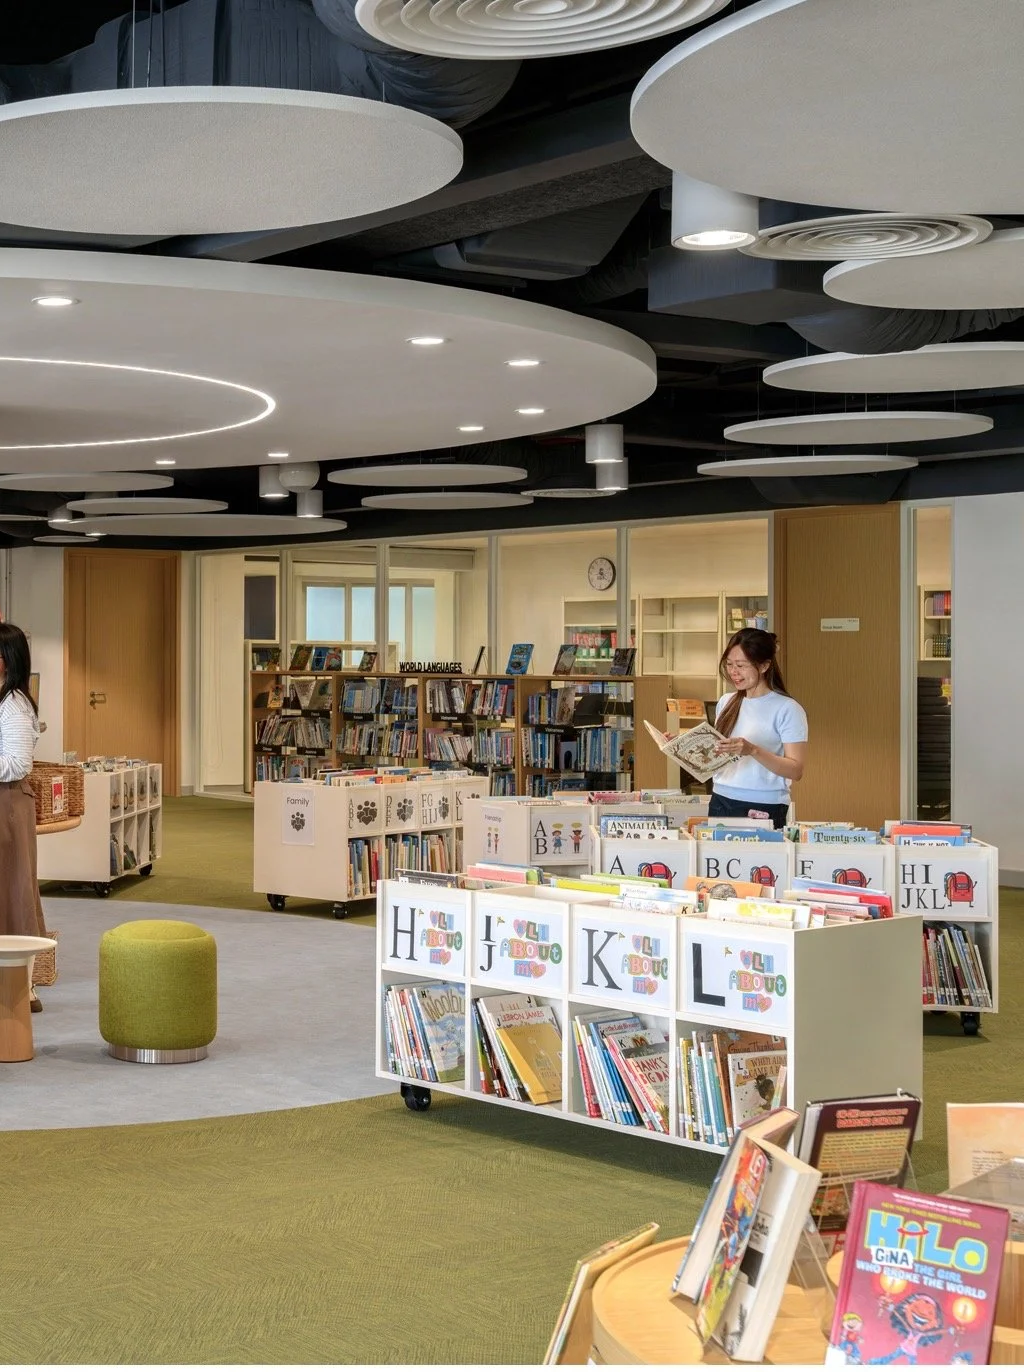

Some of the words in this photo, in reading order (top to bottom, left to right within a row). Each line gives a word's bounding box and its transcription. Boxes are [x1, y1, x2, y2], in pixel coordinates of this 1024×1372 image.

[400, 662, 422, 672] WORLD
[423, 662, 462, 673] LANGUAGES
[286, 796, 310, 806] Family
[348, 798, 354, 808] A
[386, 796, 392, 806] D
[456, 791, 462, 805] K
[348, 808, 354, 818] B
[386, 806, 392, 817] E
[456, 806, 463, 821] L
[348, 819, 354, 829] C
[386, 817, 392, 827] F
[610, 821, 656, 832] ANIMALIA
[534, 820, 548, 837] A
[814, 832, 866, 844] Twenty-six
[535, 838, 548, 855] B
[608, 854, 626, 875] A
[681, 906, 688, 914] K
[390, 906, 418, 961] H
[480, 916, 496, 942] I
[480, 944, 496, 972] J
[582, 928, 622, 990] K
[692, 942, 726, 1007] L
[421, 990, 426, 998] H
[527, 996, 532, 1004] J
[525, 1010, 544, 1020] JAMES
[497, 1018, 501, 1027] J
[600, 1030, 607, 1038] K
[618, 1040, 626, 1048] K
[632, 1056, 668, 1073] HANK'S
[738, 1062, 744, 1070] L
[751, 1056, 770, 1067] WHEN
[639, 1072, 656, 1085] BIG
[856, 1260, 882, 1274] WHO
[883, 1266, 920, 1284] BROKE
[923, 1274, 944, 1289] THE
[946, 1281, 987, 1299] WORLD
[914, 1264, 935, 1277] THE
[936, 1268, 962, 1284] GIRL
